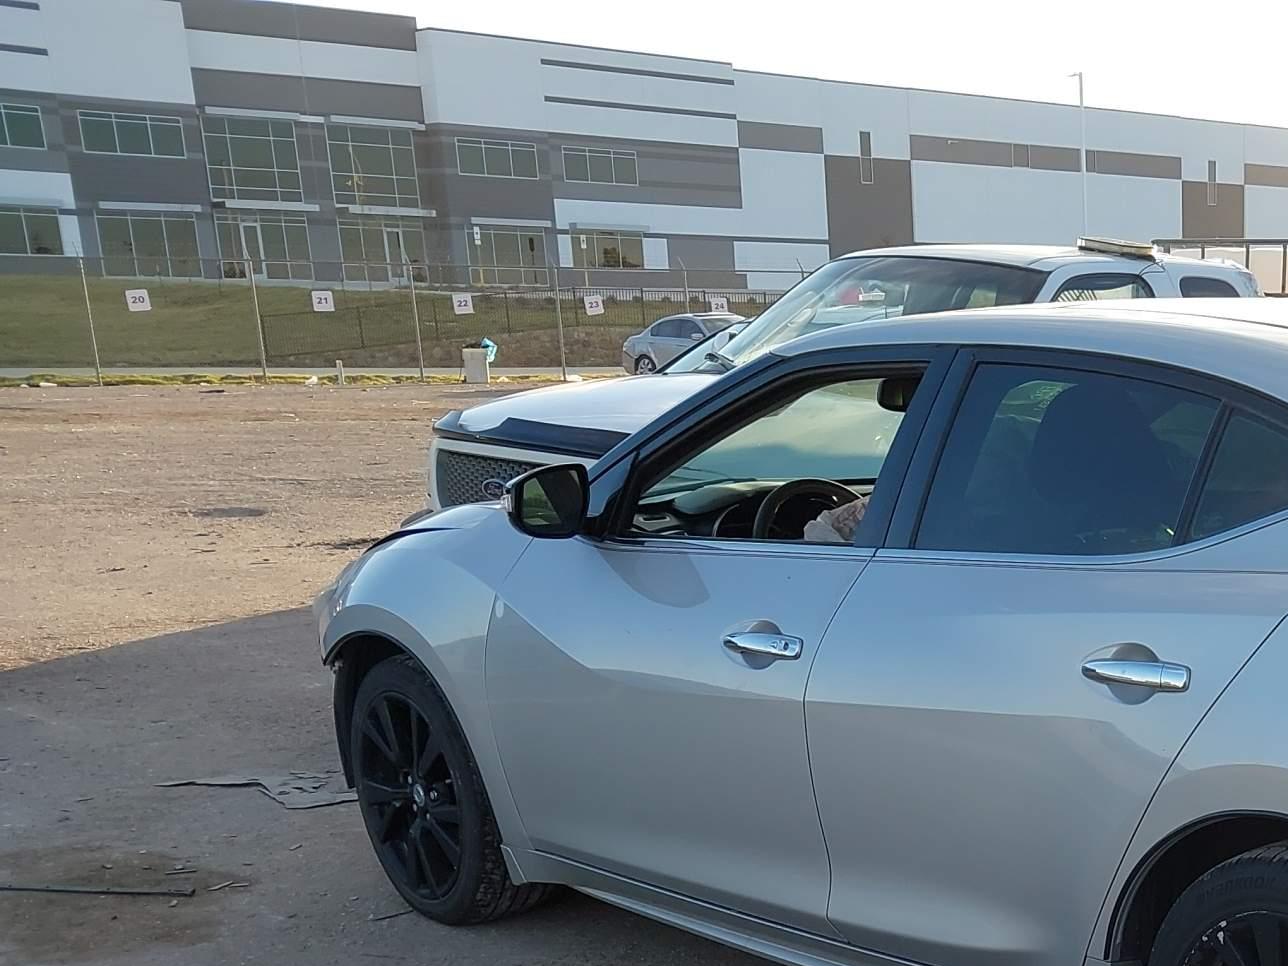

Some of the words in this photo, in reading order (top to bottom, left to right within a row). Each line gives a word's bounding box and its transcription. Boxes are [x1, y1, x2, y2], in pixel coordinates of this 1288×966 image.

[130, 295, 146, 305] 20
[316, 296, 329, 305] 21
[456, 299, 469, 308] 22
[587, 300, 600, 309] 23
[713, 302, 725, 310] 24
